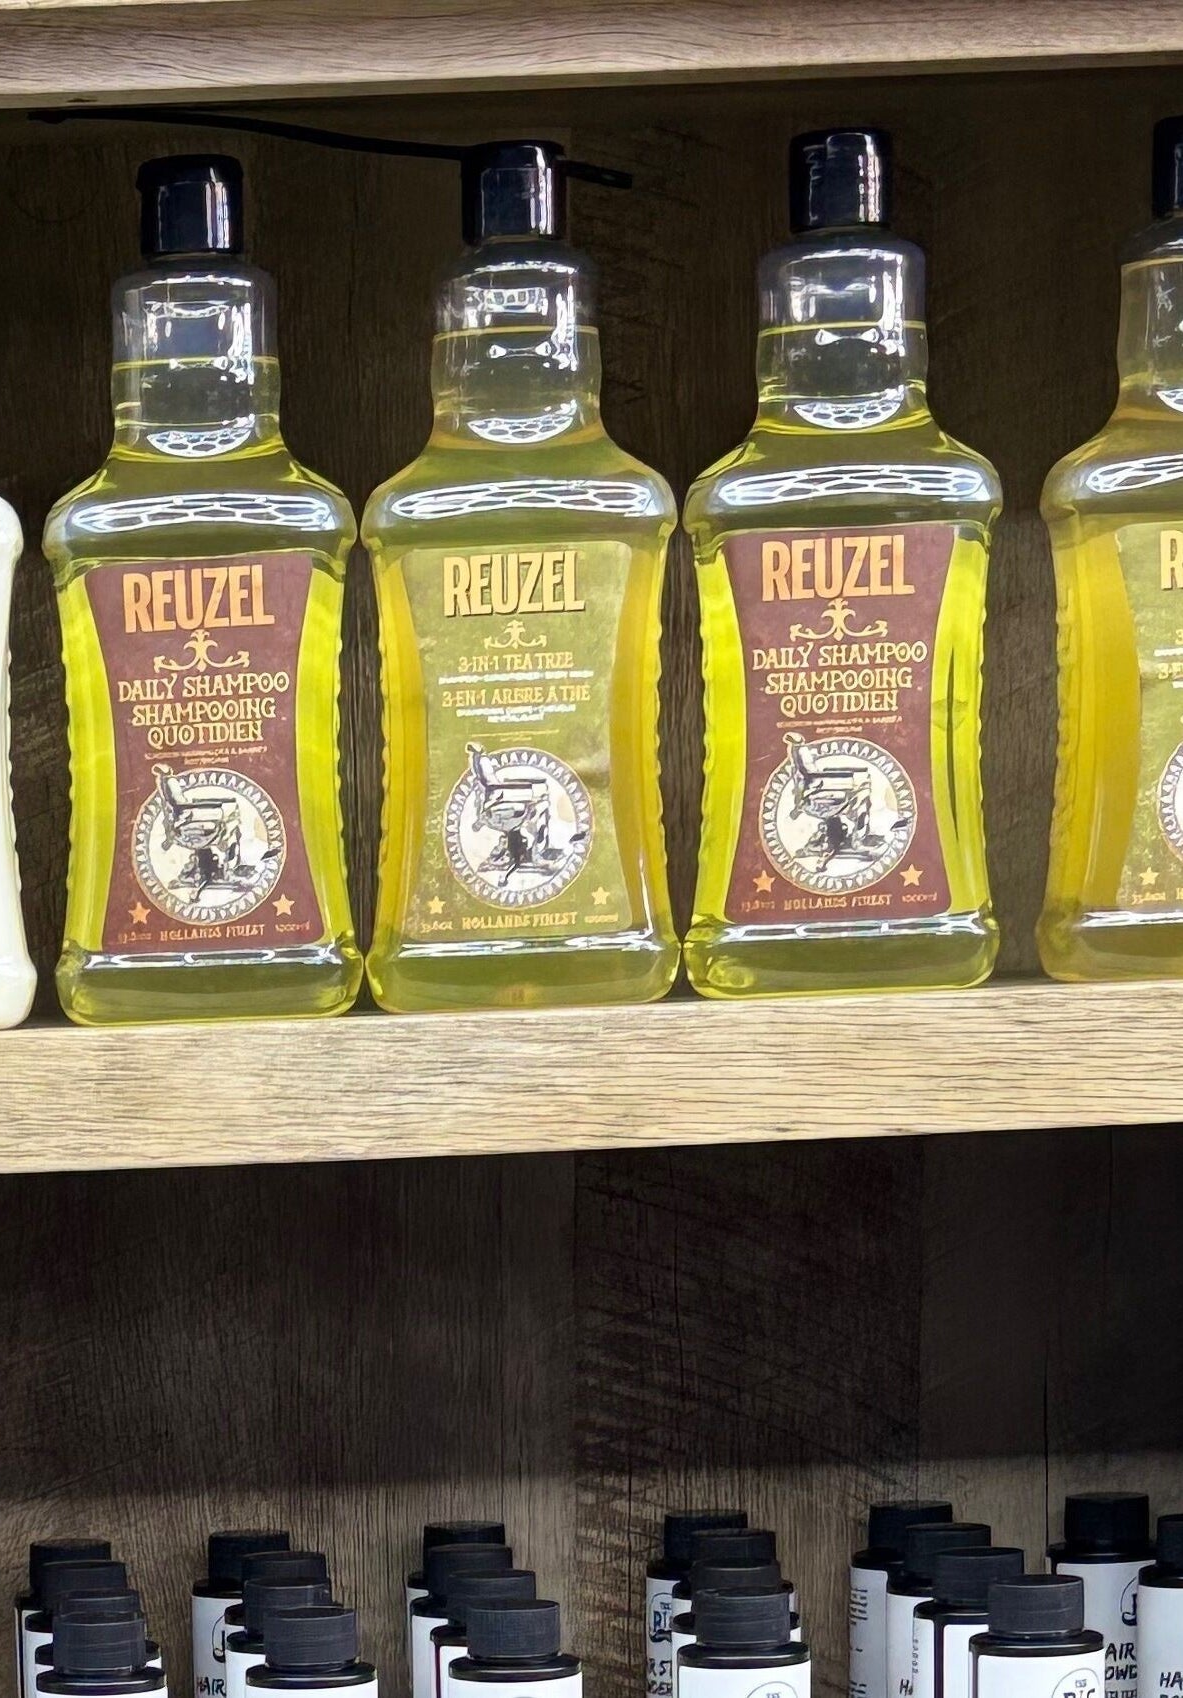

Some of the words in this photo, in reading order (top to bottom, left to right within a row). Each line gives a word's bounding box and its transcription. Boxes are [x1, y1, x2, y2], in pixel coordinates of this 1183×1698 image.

[761, 534, 915, 602] REUZEL
[122, 564, 275, 634] REUZEL
[442, 551, 586, 618] REUZEL
[503, 653, 533, 671] TEA
[534, 651, 574, 670] TREE
[752, 642, 814, 670] DAILY
[818, 641, 928, 667] SHAMPOO
[118, 673, 178, 702] DAILY
[182, 671, 290, 698] SHAMPOO
[765, 667, 913, 695] SHAMPOOING
[132, 697, 276, 726] SHAMPOOING
[780, 690, 899, 718] QUOTIDIEN
[147, 720, 264, 750] QUOTIDIEN
[1104, 1643, 1137, 1661] AIR
